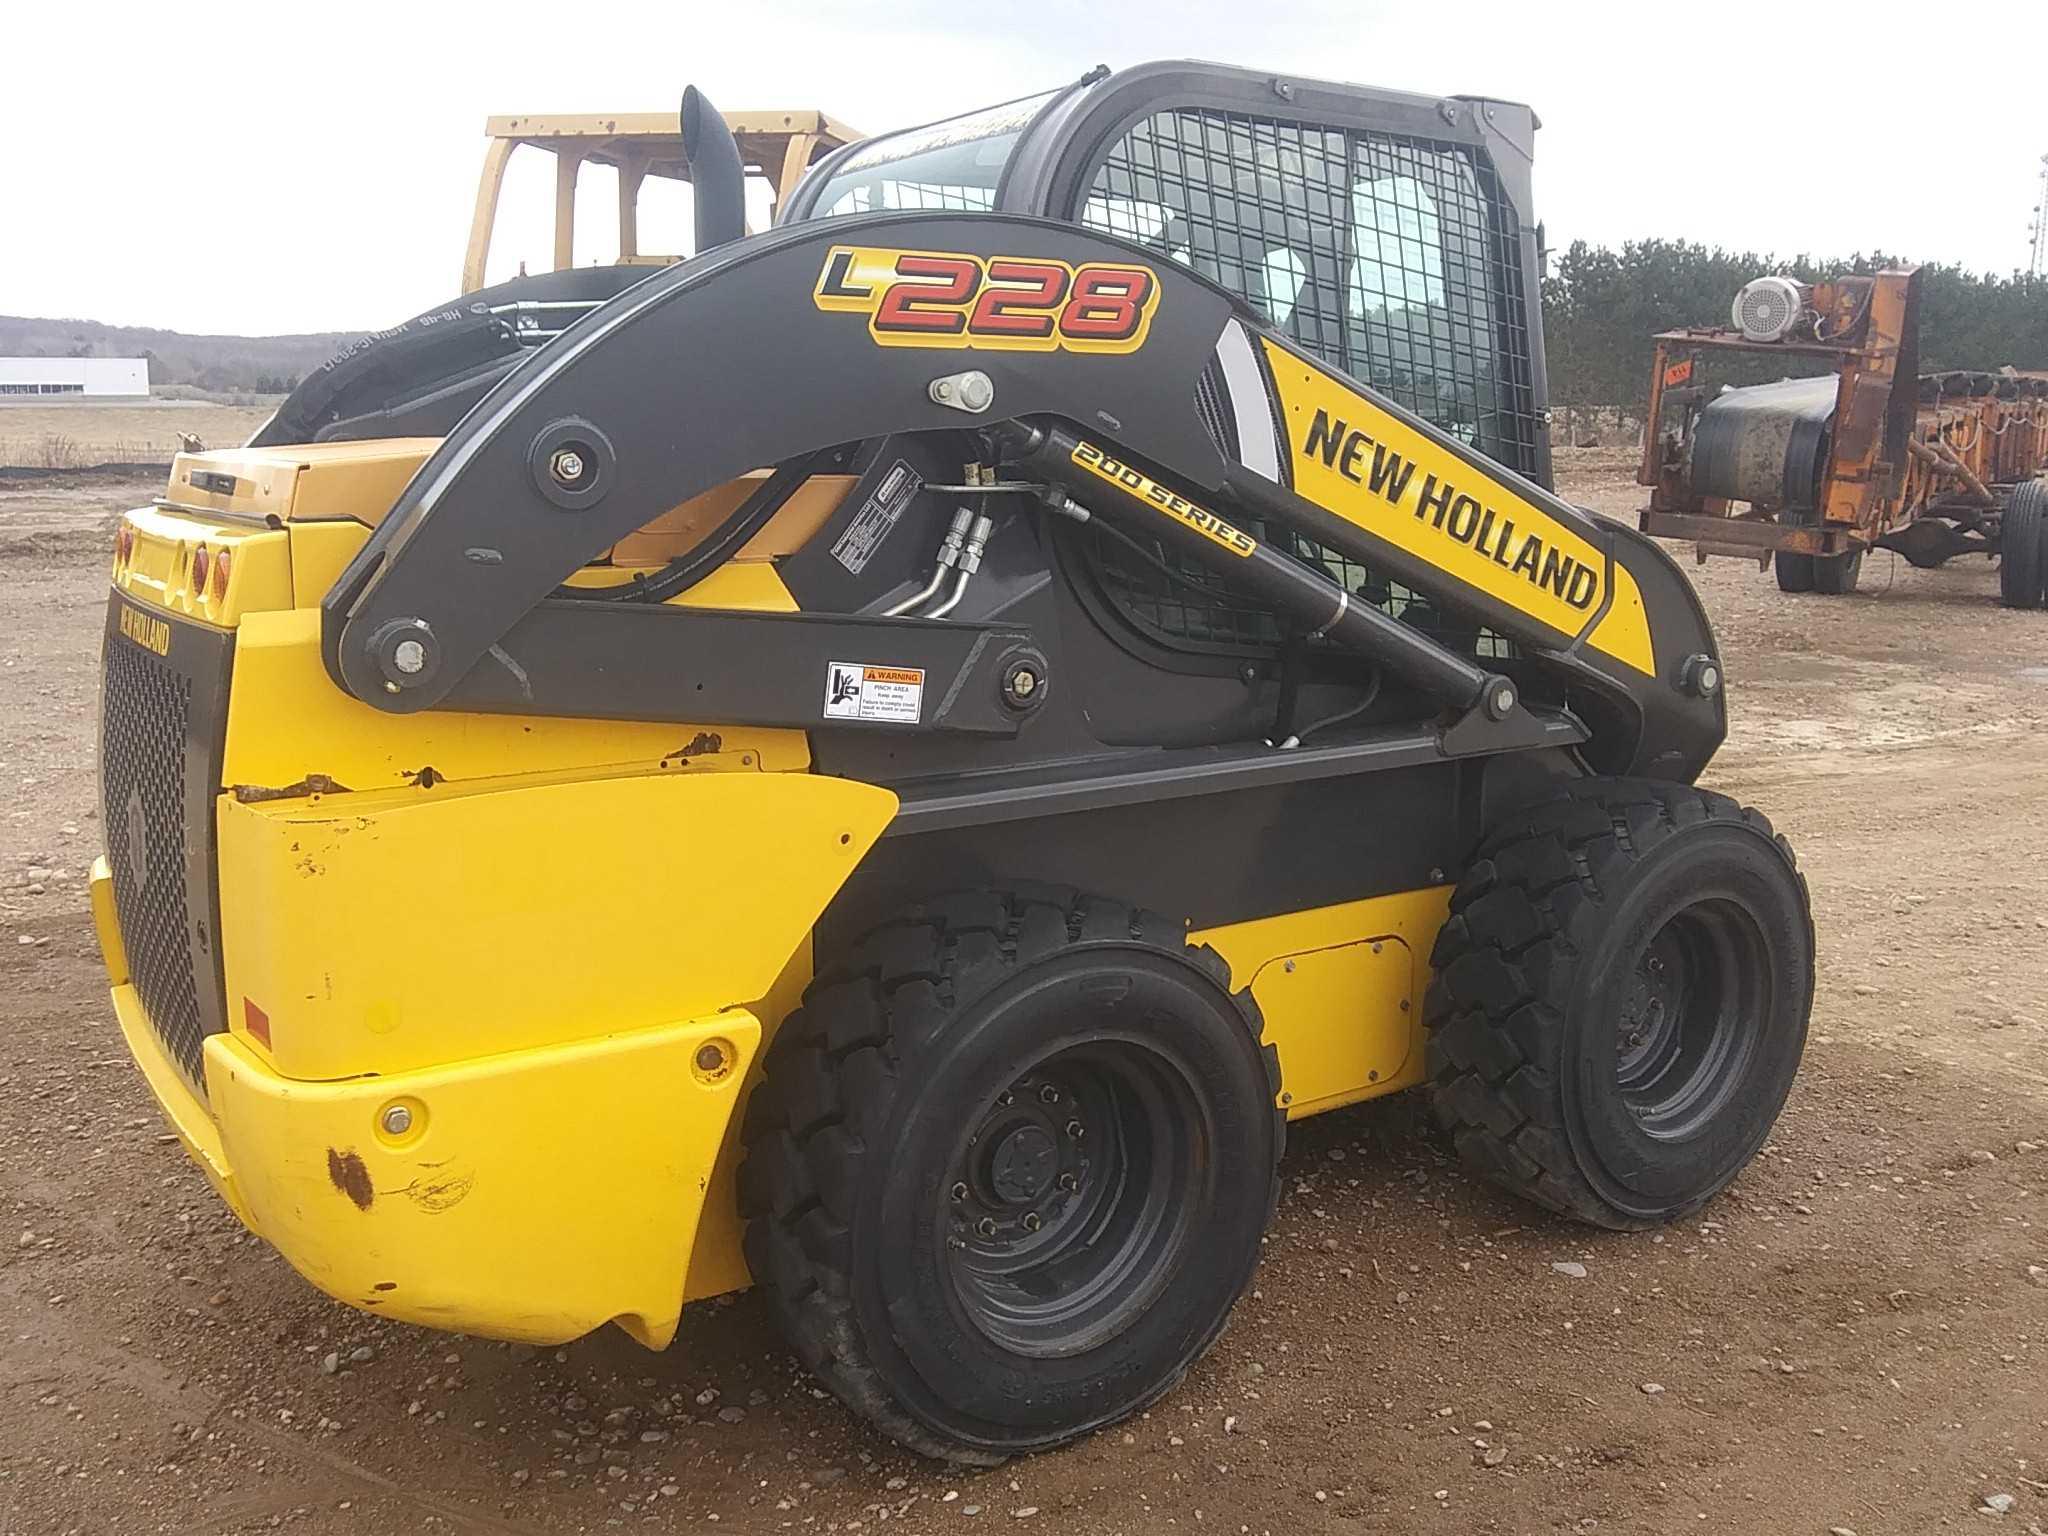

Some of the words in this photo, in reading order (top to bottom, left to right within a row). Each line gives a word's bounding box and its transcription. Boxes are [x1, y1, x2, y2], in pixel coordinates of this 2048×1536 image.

[818, 248, 1156, 342] L228
[1074, 443, 1144, 491] 200
[1143, 480, 1255, 554] SERIES
[1303, 407, 1417, 505] NEW
[1413, 473, 1599, 611] HOLLAND
[132, 610, 170, 657] HOLLAND
[878, 671, 918, 682] WARNING
